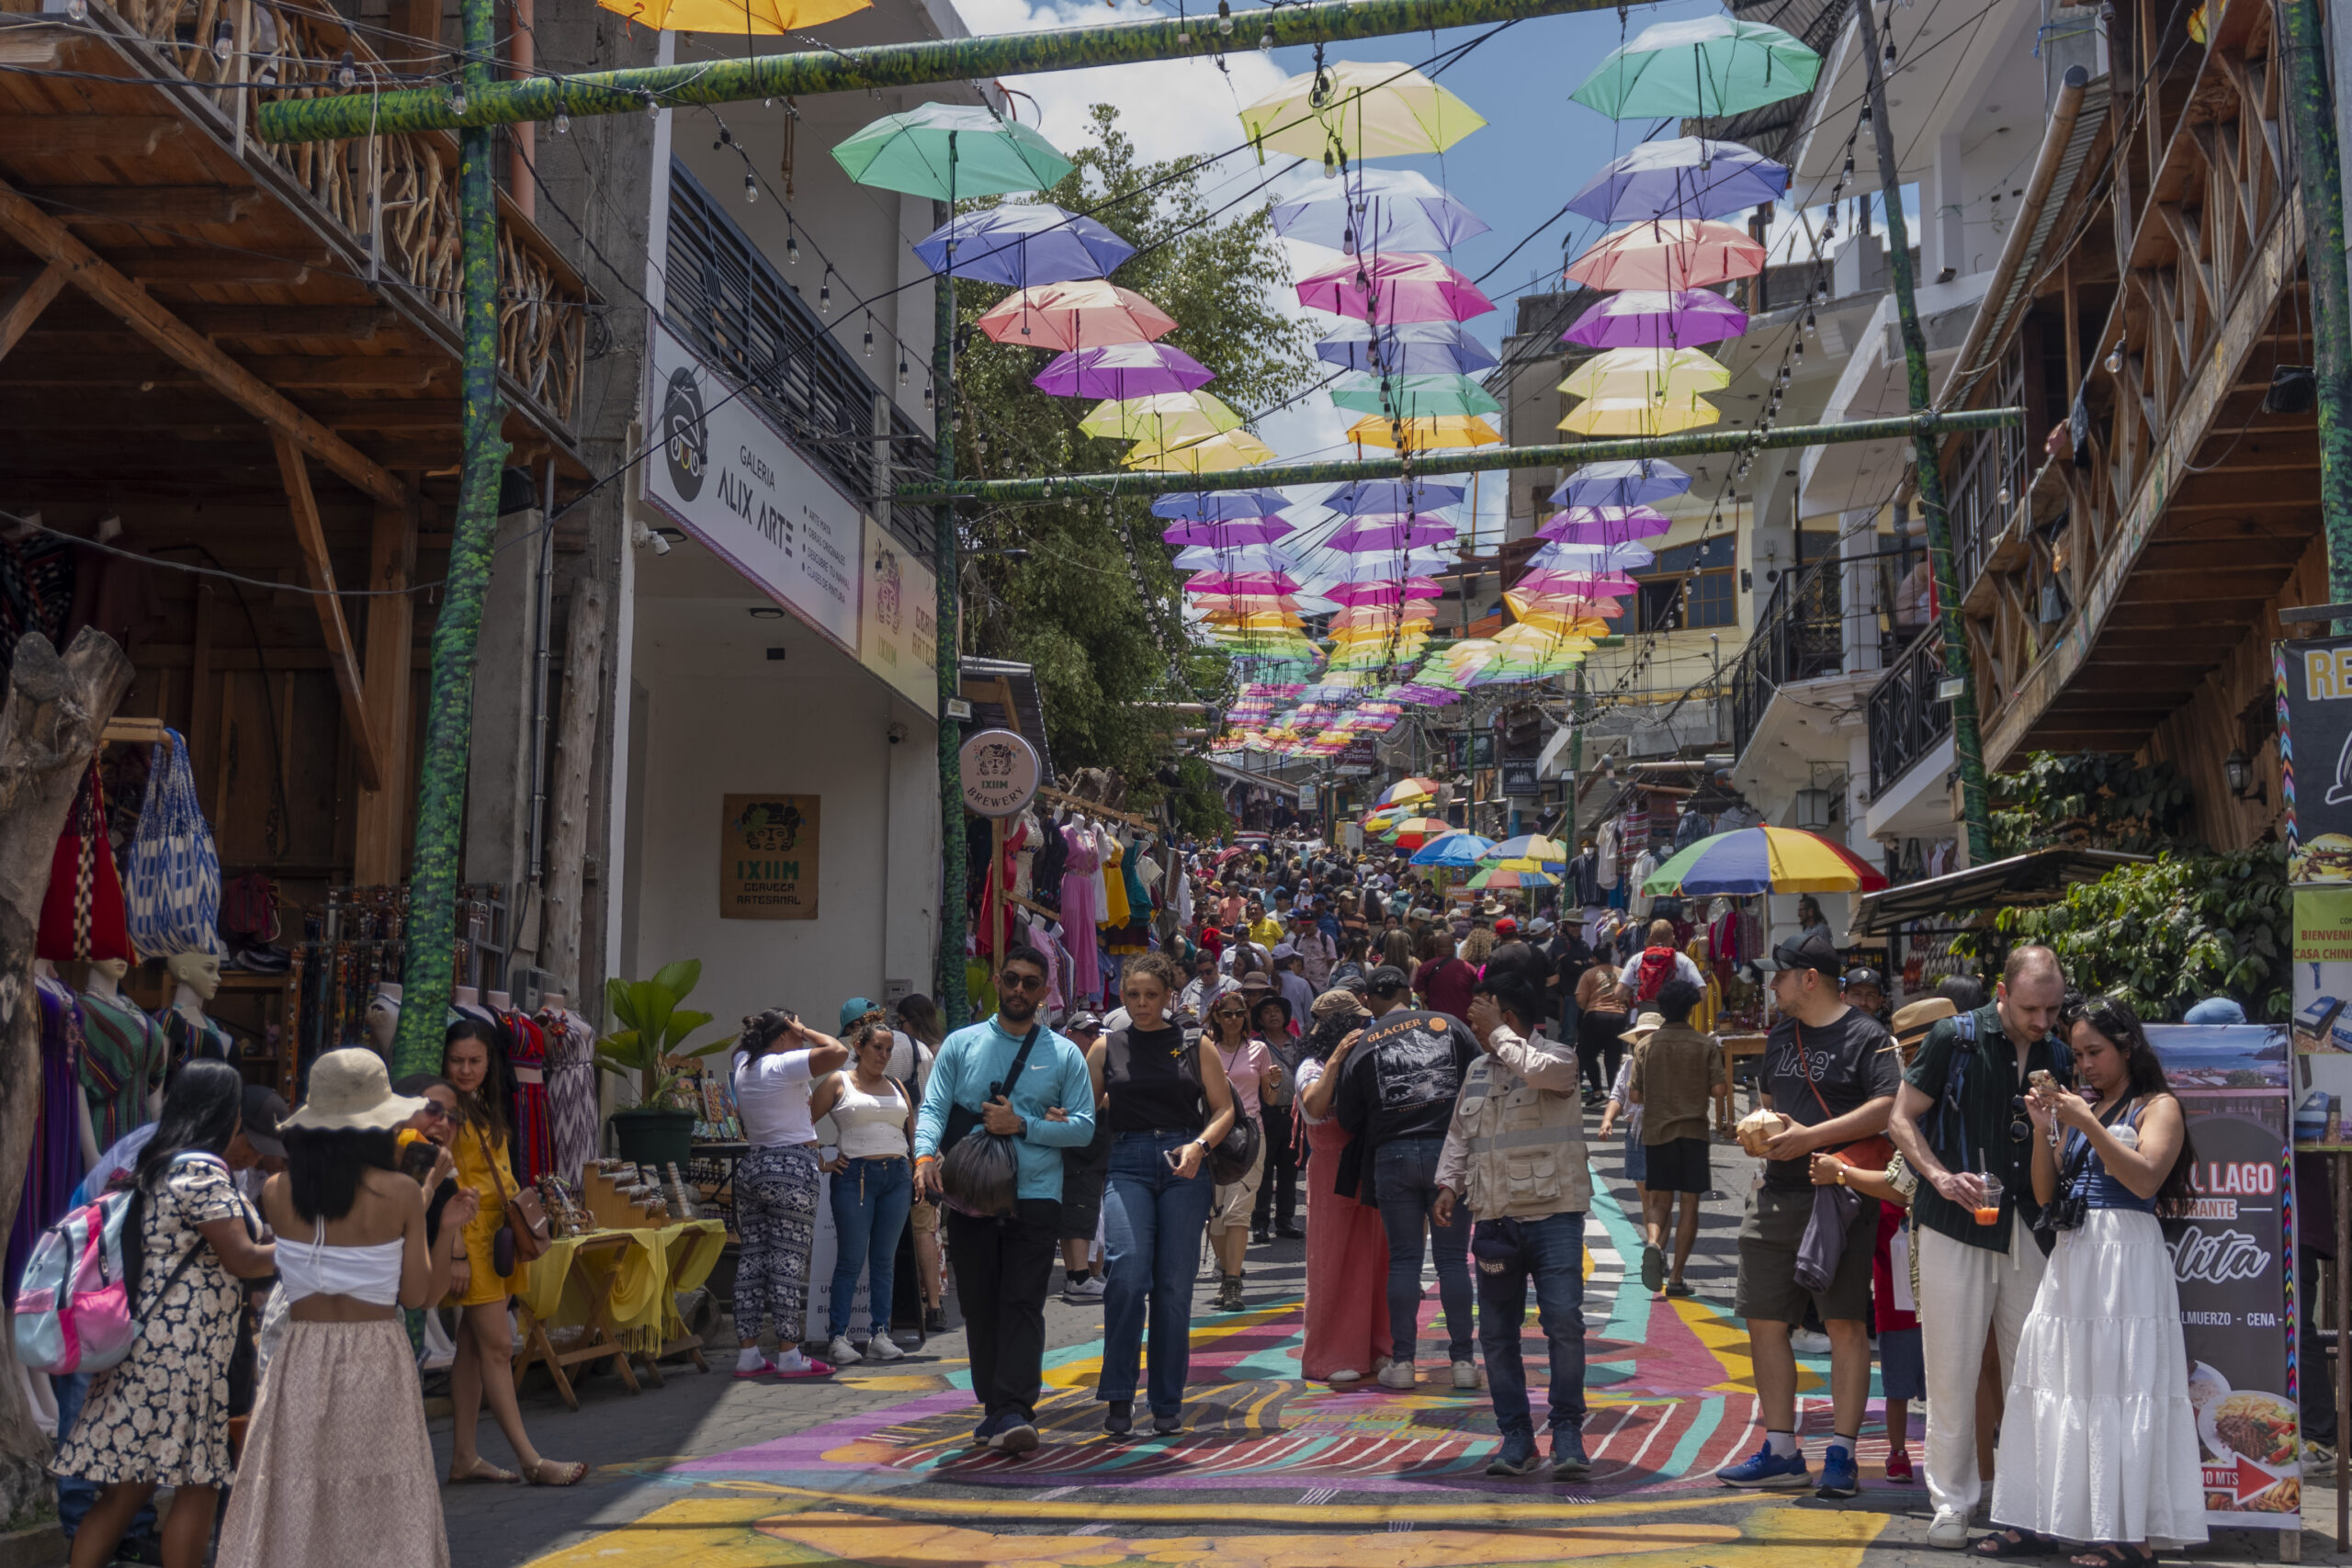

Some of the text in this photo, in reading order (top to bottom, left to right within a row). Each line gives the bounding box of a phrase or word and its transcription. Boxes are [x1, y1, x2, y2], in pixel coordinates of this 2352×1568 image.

[740, 445, 775, 491] GALERIA
[718, 466, 793, 558] ALIX ARTE
[808, 509, 831, 536] ARTE MAYA
[808, 526, 845, 566] OBRAS ORIGINALES
[808, 547, 828, 572] DESCUBRE
[830, 564, 835, 579] TU
[807, 565, 845, 604] CLASES DE PINTURA
[967, 786, 1023, 807] BREWERY
[982, 780, 1008, 789] IXIIM
[738, 860, 799, 880] IXIIM
[744, 883, 794, 892] CERVEZA
[737, 896, 801, 905] ARTESANAL
[2293, 948, 2320, 960] CASA
[1367, 1018, 1422, 1043] GLACIER
[1774, 1042, 1829, 1082] Lee
[2209, 1161, 2276, 1196] LAGO
[2181, 1311, 2276, 1326] LMUERZO CENA
[2215, 1472, 2239, 1485] MTS
